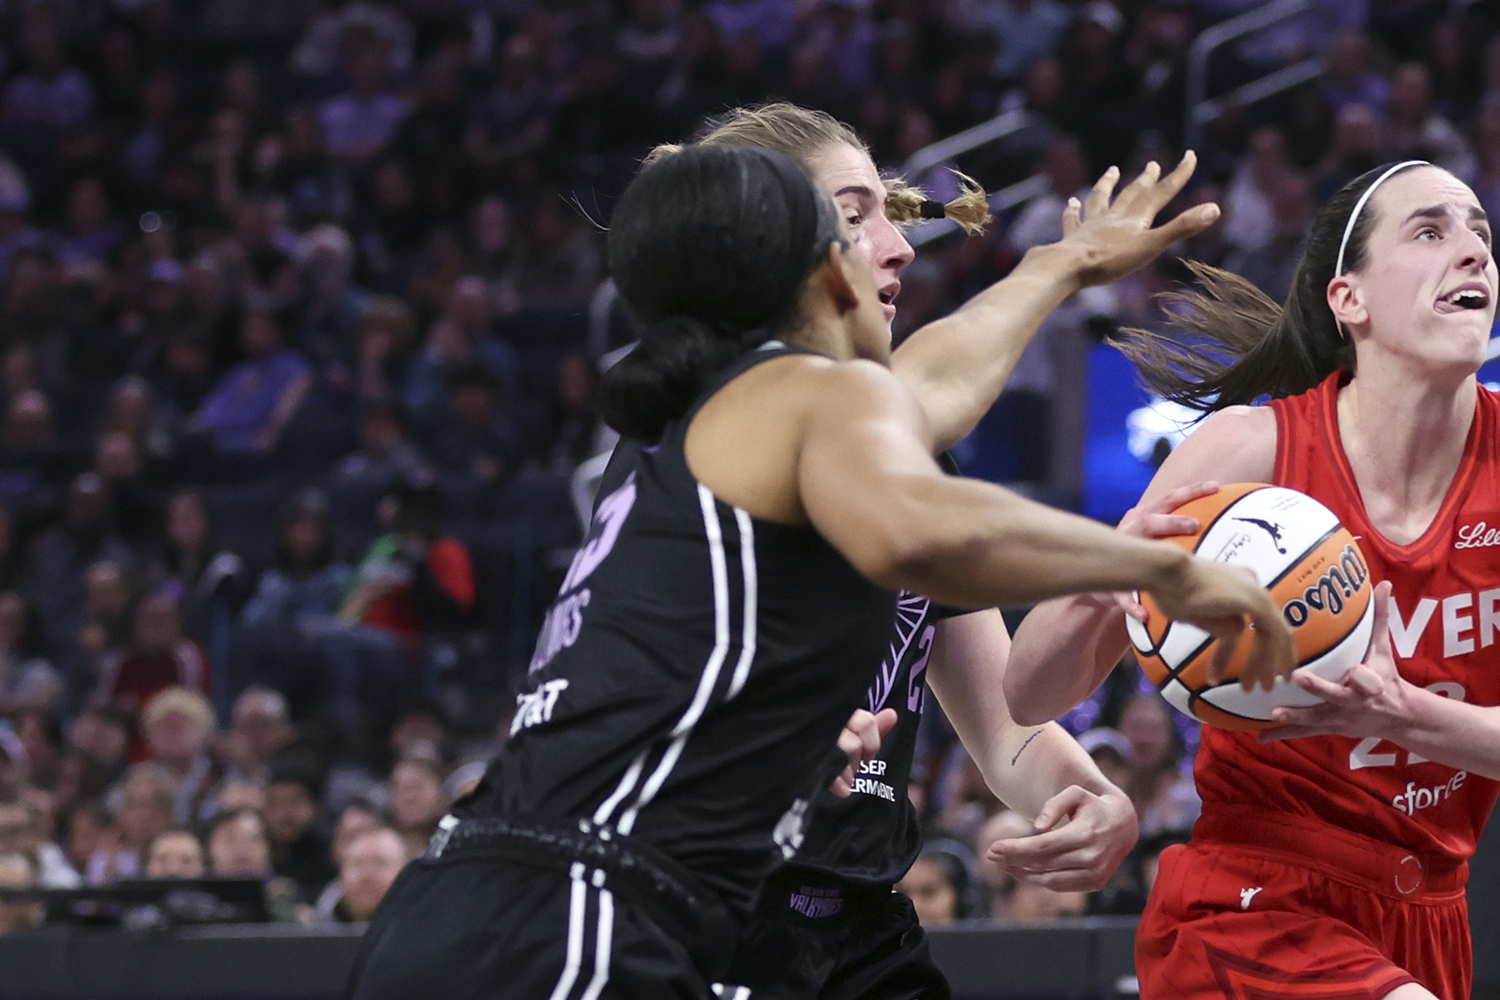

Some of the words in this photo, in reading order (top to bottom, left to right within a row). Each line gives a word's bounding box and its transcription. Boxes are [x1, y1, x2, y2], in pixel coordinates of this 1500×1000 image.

[1282, 543, 1367, 628] Wilso
[907, 624, 936, 715] 2
[856, 760, 887, 776] SER
[1392, 770, 1468, 817] sforce
